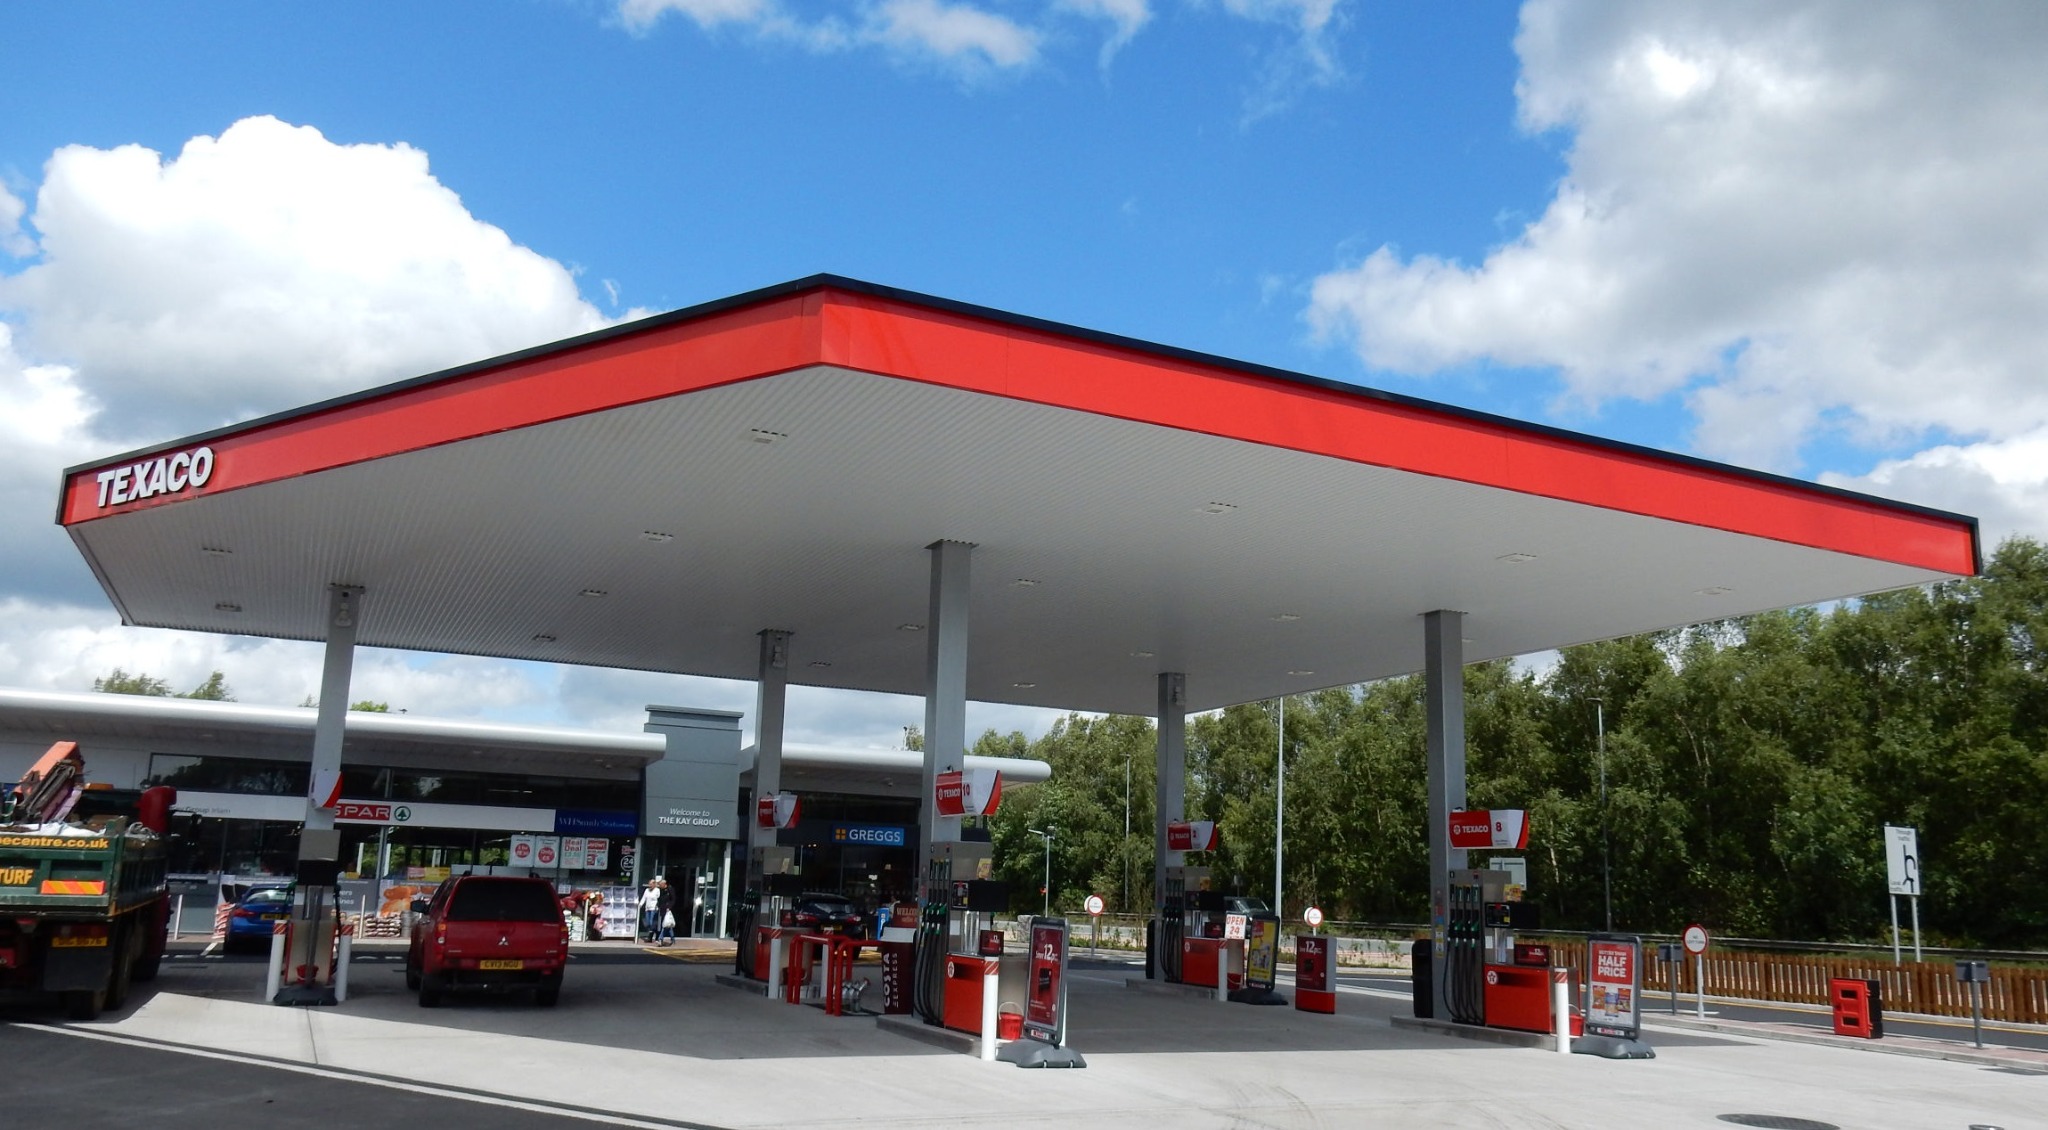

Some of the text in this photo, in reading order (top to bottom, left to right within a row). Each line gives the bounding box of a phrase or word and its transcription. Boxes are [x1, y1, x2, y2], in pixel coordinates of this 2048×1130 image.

[97, 446, 214, 507] TEXACO
[943, 783, 971, 798] TEXACO 10
[335, 806, 389, 818] SPAR
[670, 808, 701, 817] Welcome
[658, 816, 720, 827] THE KAY GROUP
[1461, 821, 1502, 833] TEXACO 8
[849, 829, 901, 842] GREGGS
[623, 857, 634, 865] 24
[1226, 916, 1245, 925] OPEN
[1229, 926, 1240, 935] 24
[1598, 955, 1627, 967] HALF
[1597, 966, 1627, 977] PRICE
[883, 953, 891, 1007] COSTA
